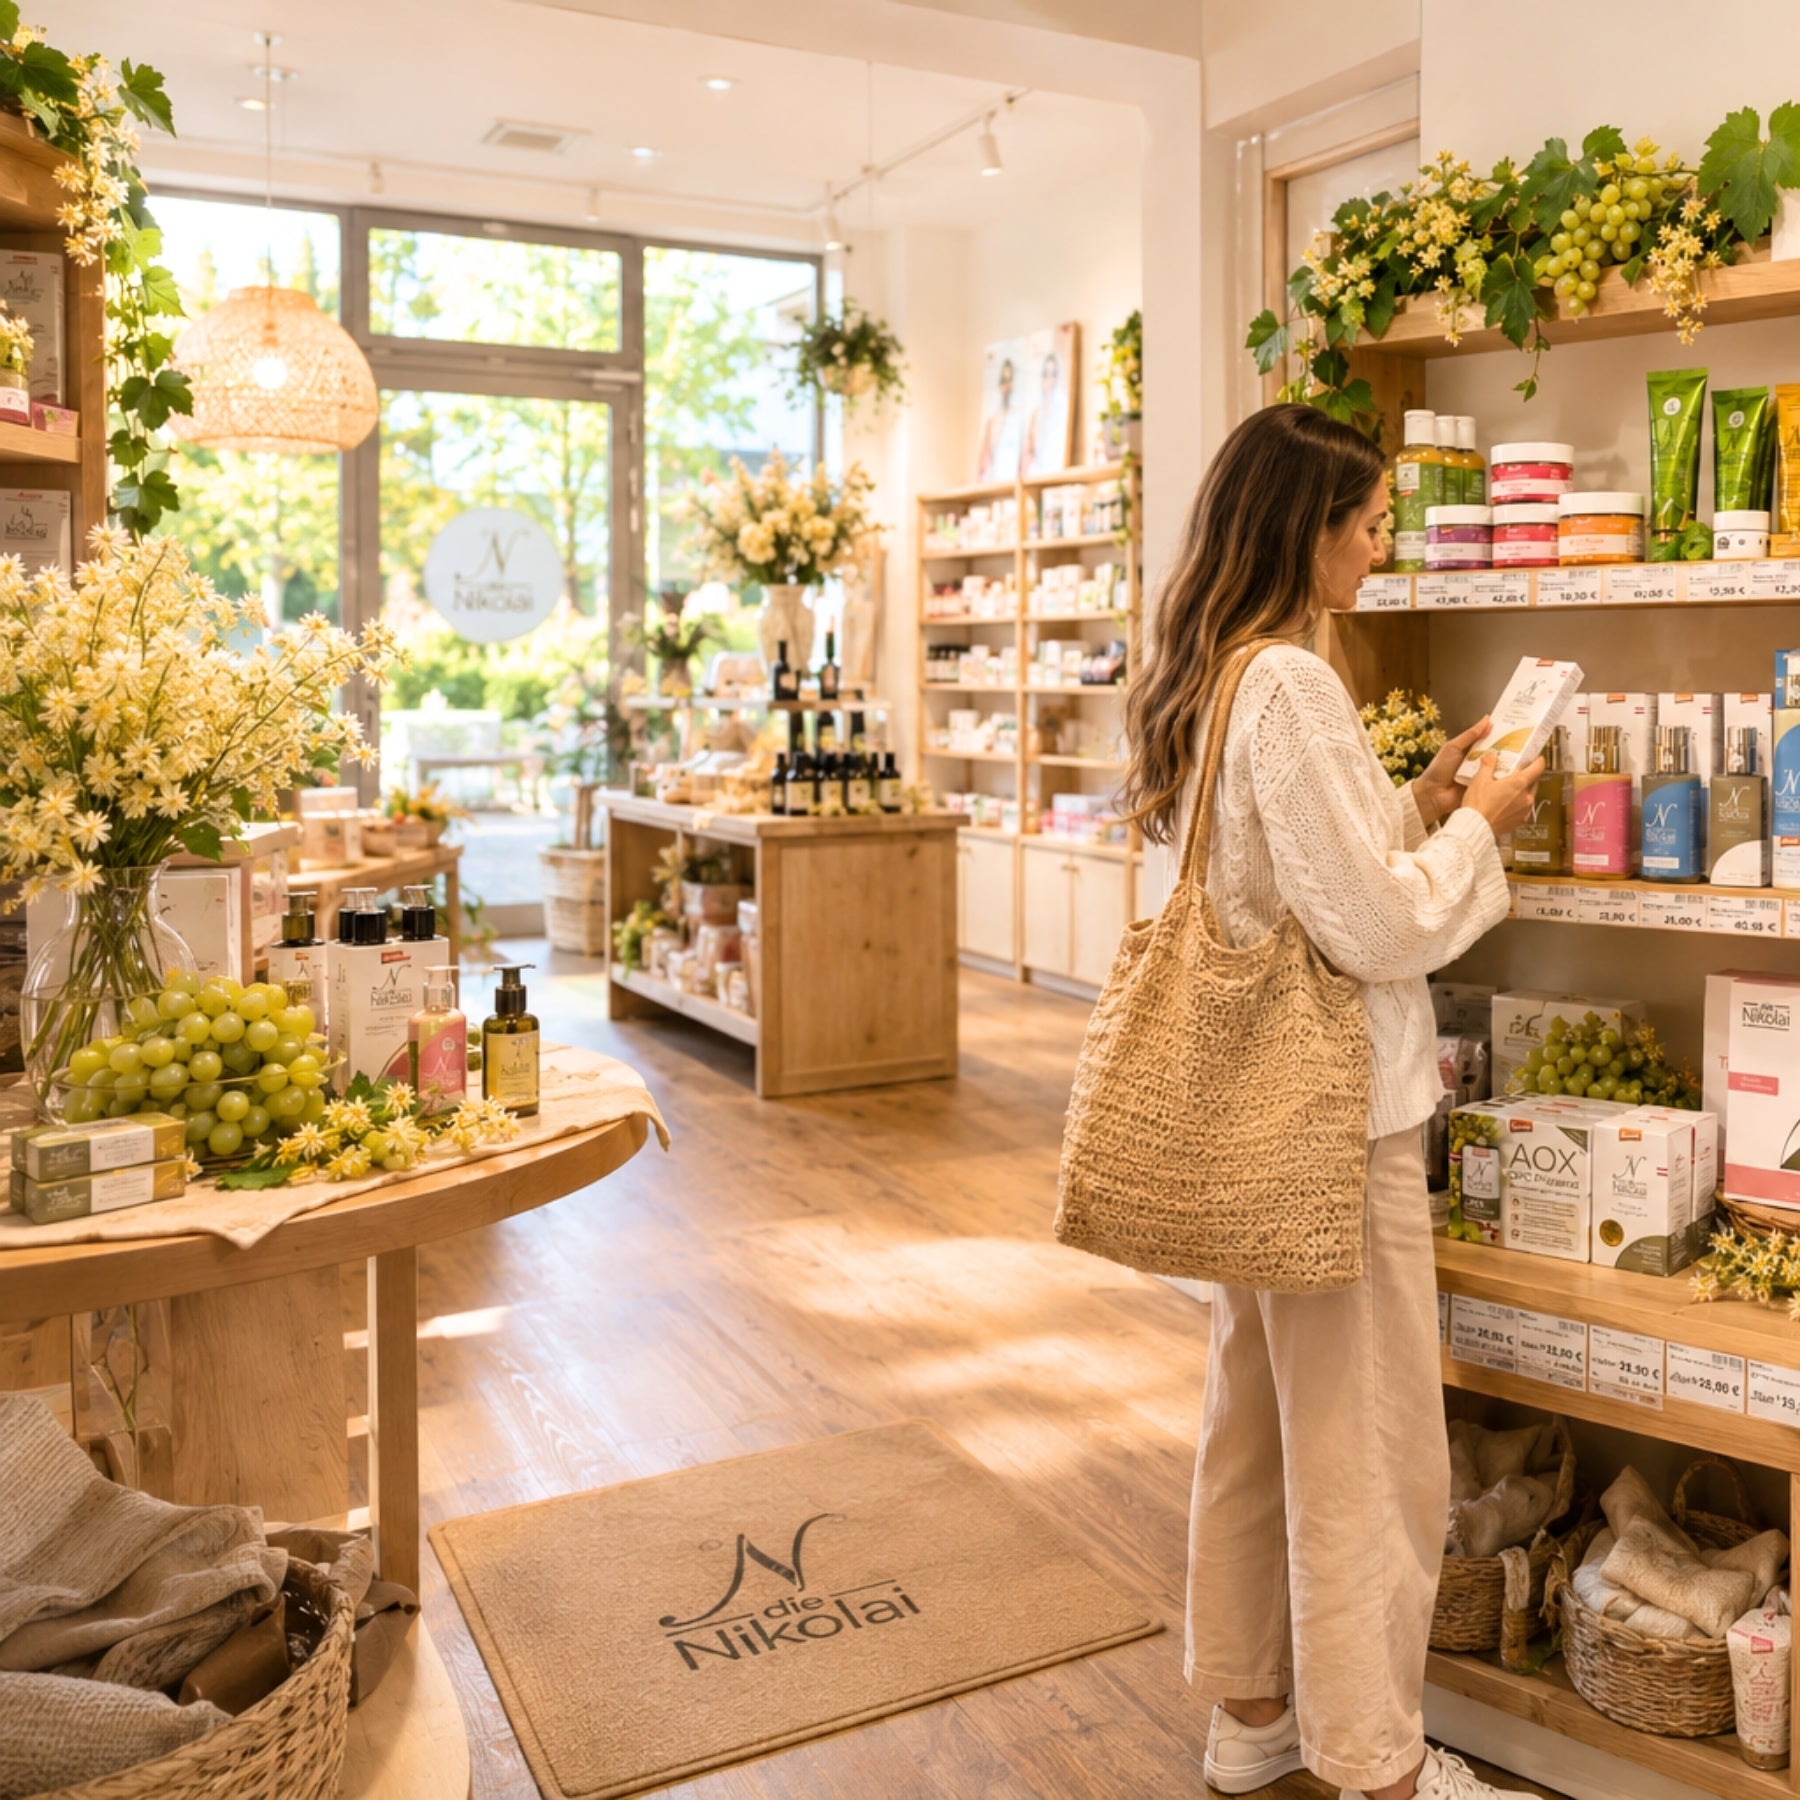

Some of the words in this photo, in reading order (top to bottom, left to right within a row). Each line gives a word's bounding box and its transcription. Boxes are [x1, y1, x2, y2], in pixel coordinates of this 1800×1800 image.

[1742, 1006, 1791, 1027] Nikolai
[1509, 1142, 1578, 1177] AOX
[659, 1513, 838, 1627] N
[763, 1596, 825, 1619] die
[673, 1586, 921, 1671] Nikolai
